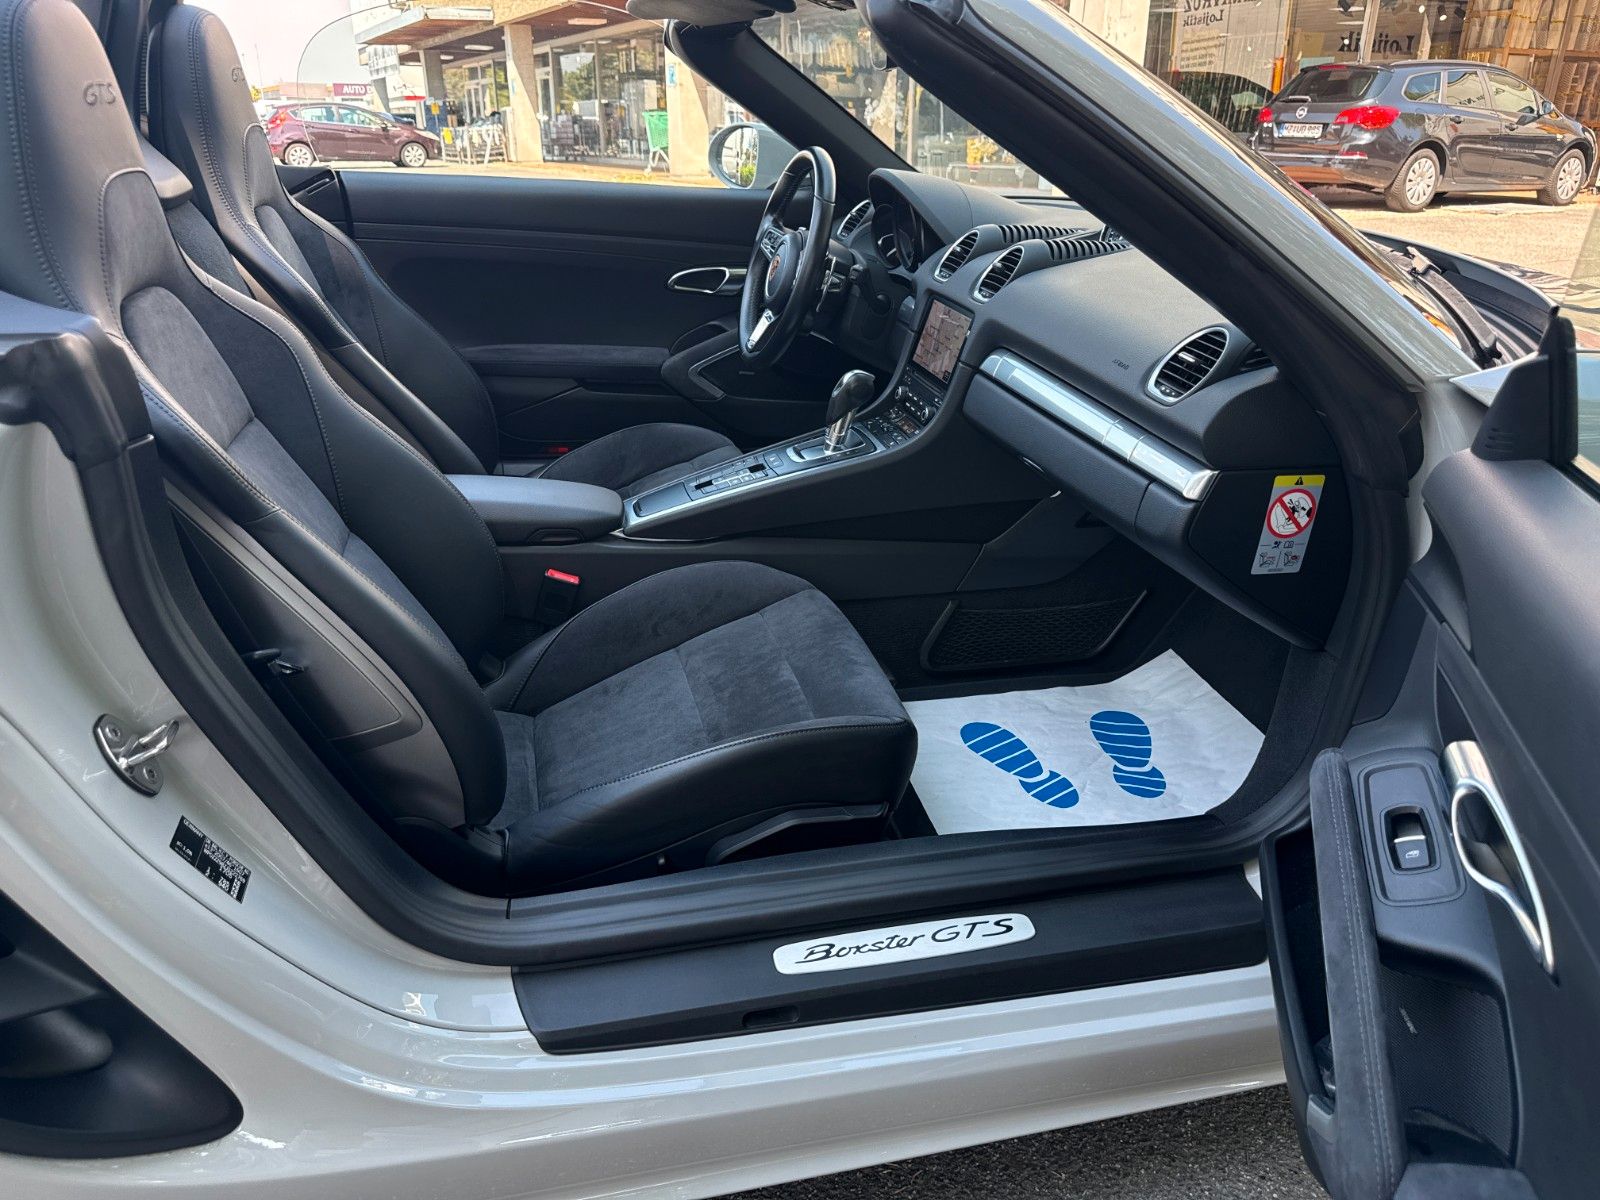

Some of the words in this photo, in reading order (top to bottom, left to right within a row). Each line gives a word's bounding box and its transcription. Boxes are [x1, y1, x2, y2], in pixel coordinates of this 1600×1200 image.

[83, 82, 116, 106] GTS
[342, 85, 366, 95] AUTO
[795, 934, 926, 964] Boxster
[931, 918, 1014, 943] GTS
